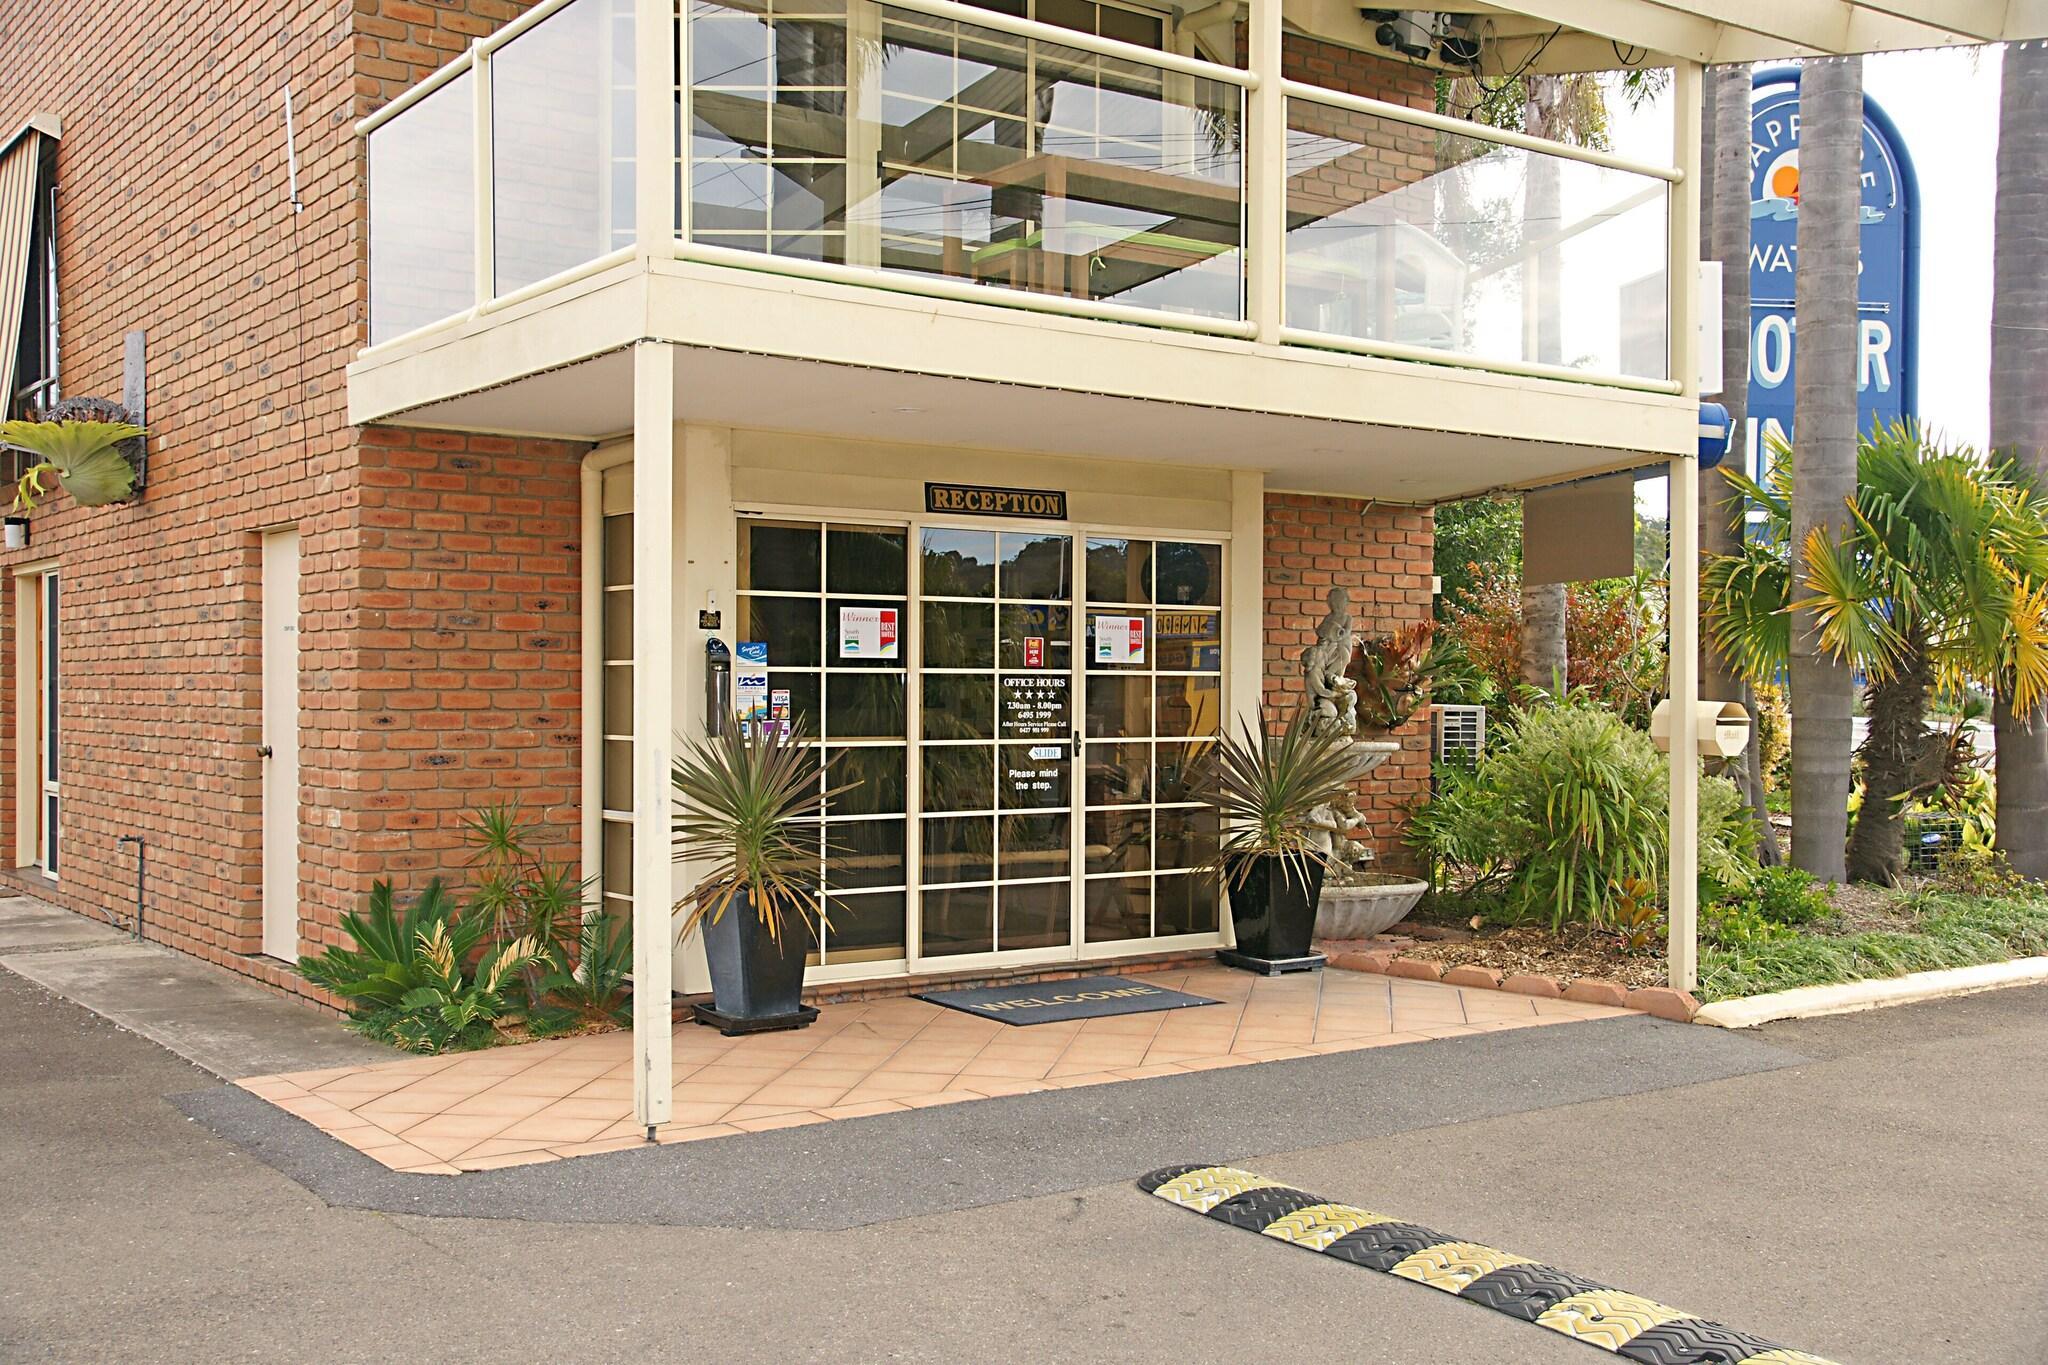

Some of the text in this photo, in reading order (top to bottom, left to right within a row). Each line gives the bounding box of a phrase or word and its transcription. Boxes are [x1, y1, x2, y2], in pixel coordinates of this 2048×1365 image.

[933, 489, 1059, 514] RECEPTION
[842, 612, 879, 622] Winner
[881, 622, 895, 631] BEST
[1097, 621, 1128, 630] Winner
[1003, 678, 1066, 688] OFFICE HOURS
[1037, 702, 1062, 711] 8.00pm
[1017, 711, 1052, 719] 6495 1999
[1034, 748, 1059, 757] SLIDE
[1009, 768, 1058, 778] Please mind
[1015, 781, 1052, 791] the step.
[969, 987, 1163, 1012] WELCOME
